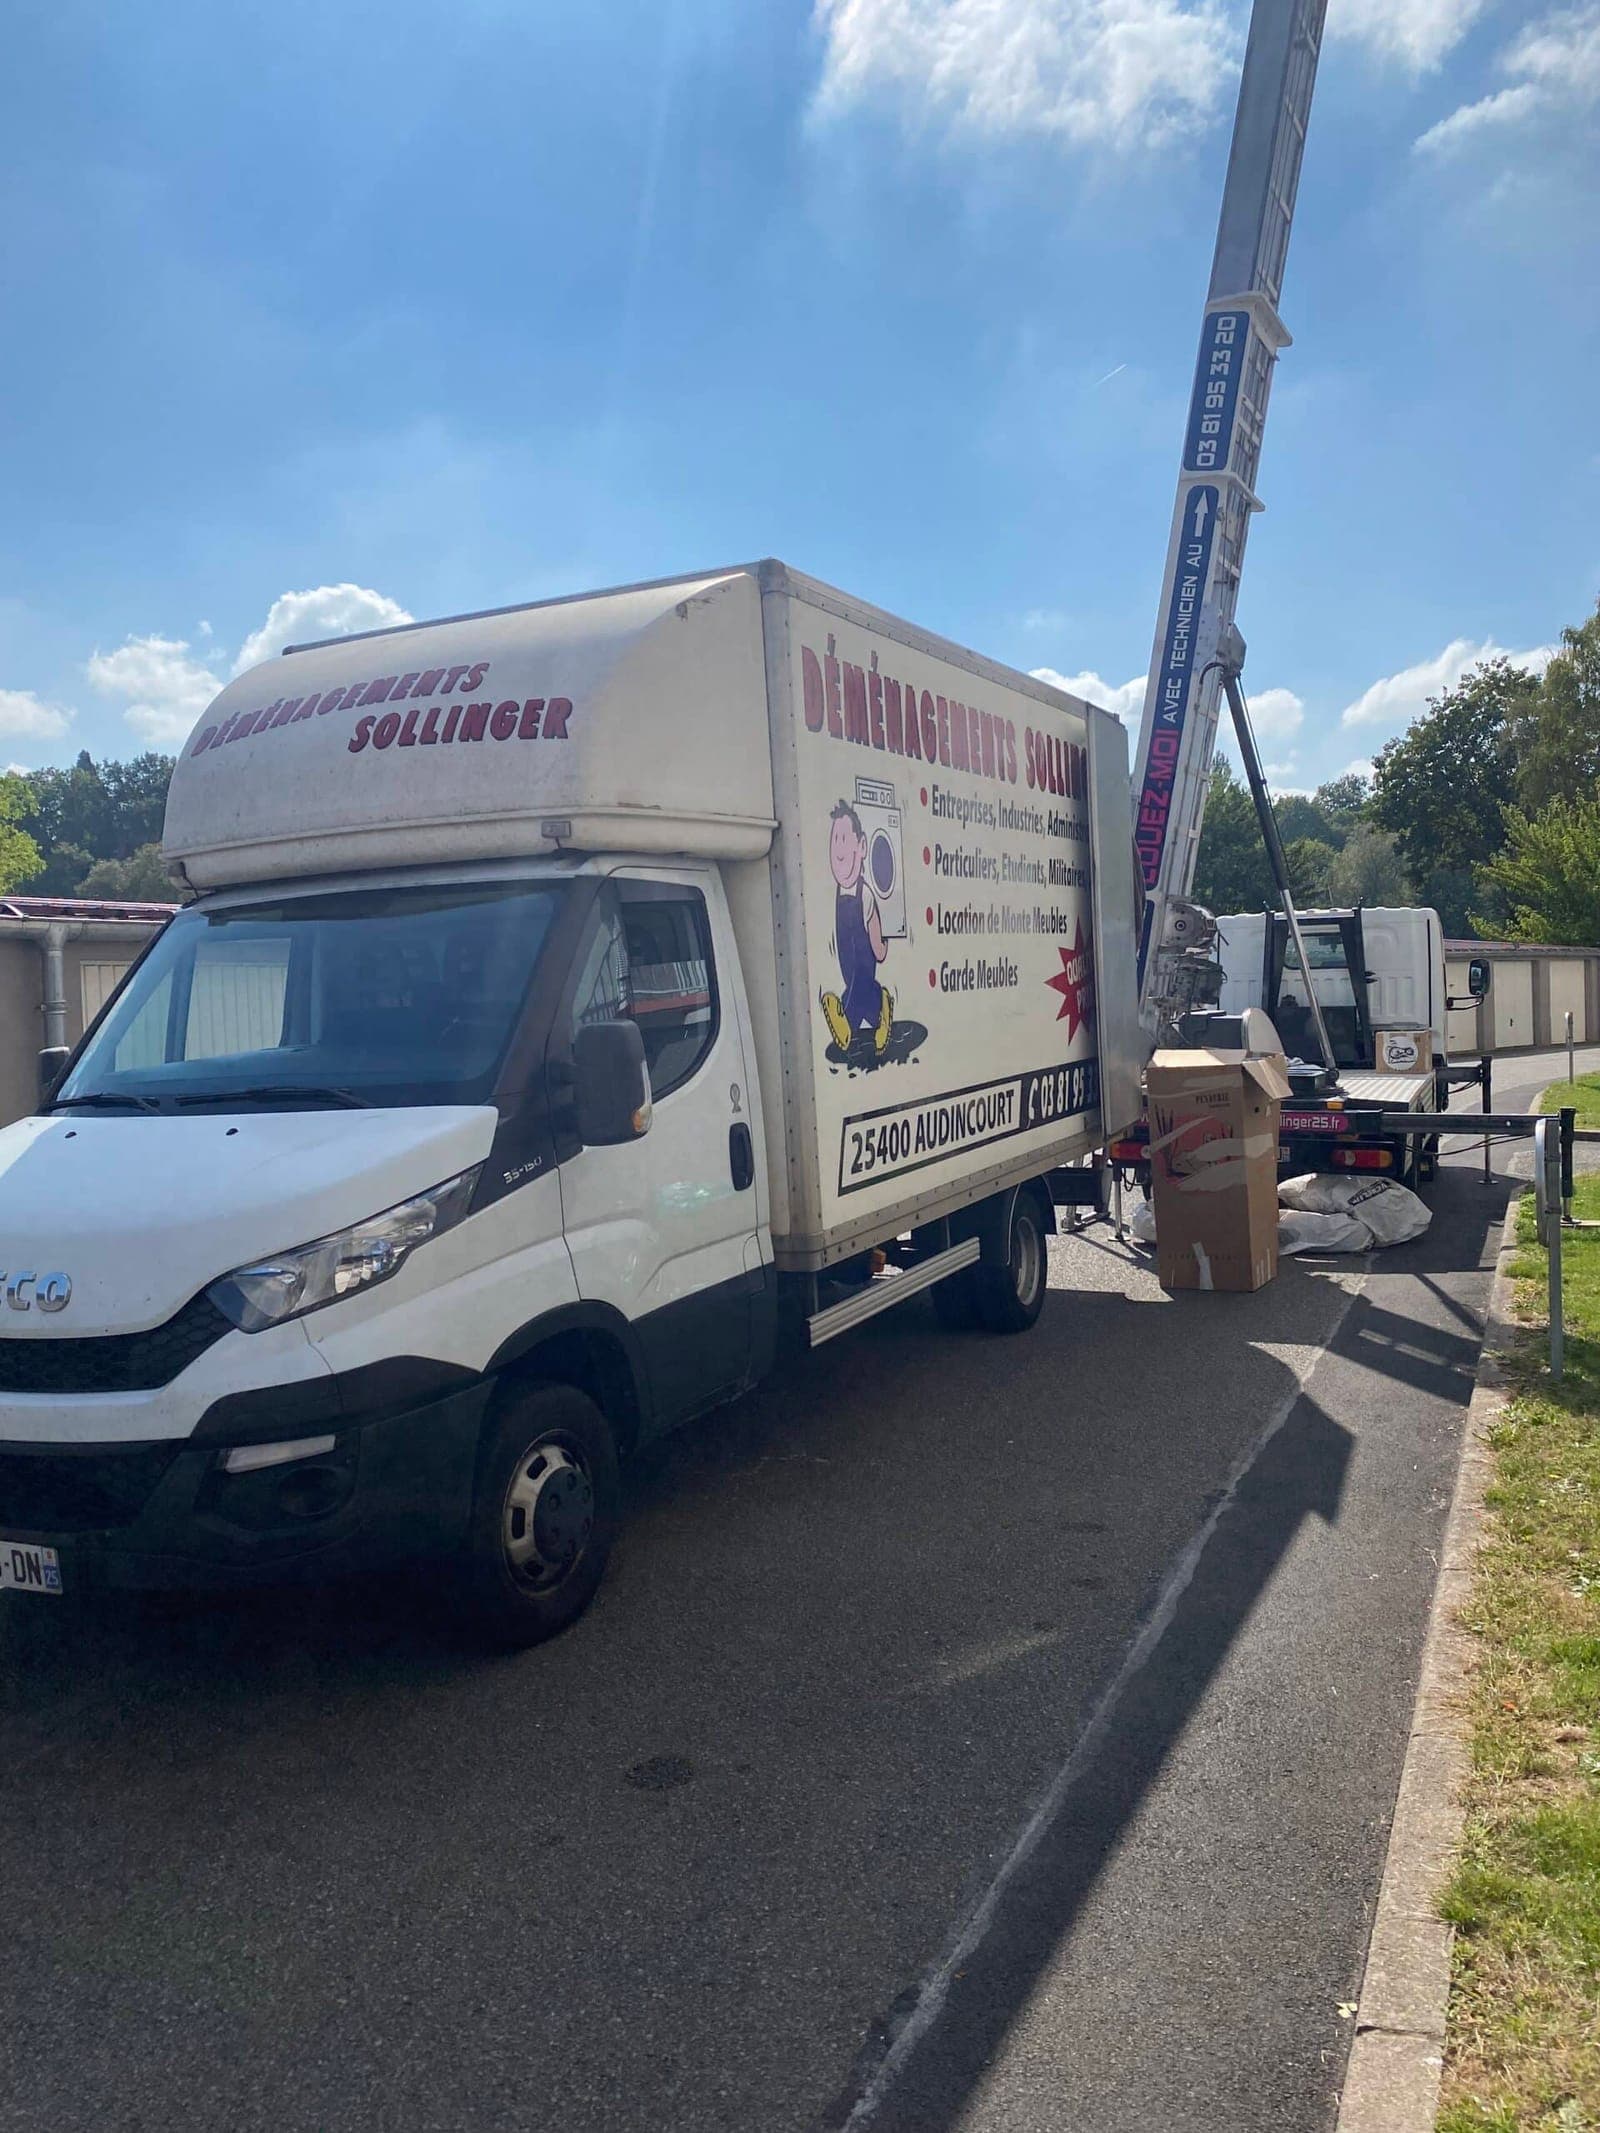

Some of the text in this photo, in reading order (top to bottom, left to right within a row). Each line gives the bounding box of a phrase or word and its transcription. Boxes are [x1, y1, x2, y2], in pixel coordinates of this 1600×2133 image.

[1196, 316, 1237, 466] 03 81 95 33 20
[1186, 544, 1203, 568] AU
[1170, 575, 1198, 670] TECHNICIEN
[190, 662, 490, 757] DÉMÉNAGEMENTS
[348, 697, 573, 753] SOLLINGER
[801, 633, 1016, 785] DÉMÉNAGEMENTS
[1163, 678, 1182, 723] AVEC
[932, 784, 996, 830] Entreprises,
[999, 799, 1045, 838] Industries,
[935, 843, 1000, 885] Particuliers,
[938, 902, 1067, 934] Location de Monte Meubles
[940, 957, 1018, 992] Garde Meubles
[1041, 1075, 1054, 1119] 03
[1057, 1071, 1069, 1113] 81
[1073, 1068, 1084, 1109] 95
[850, 1089, 1014, 1174] 25400 AUDINCOURT
